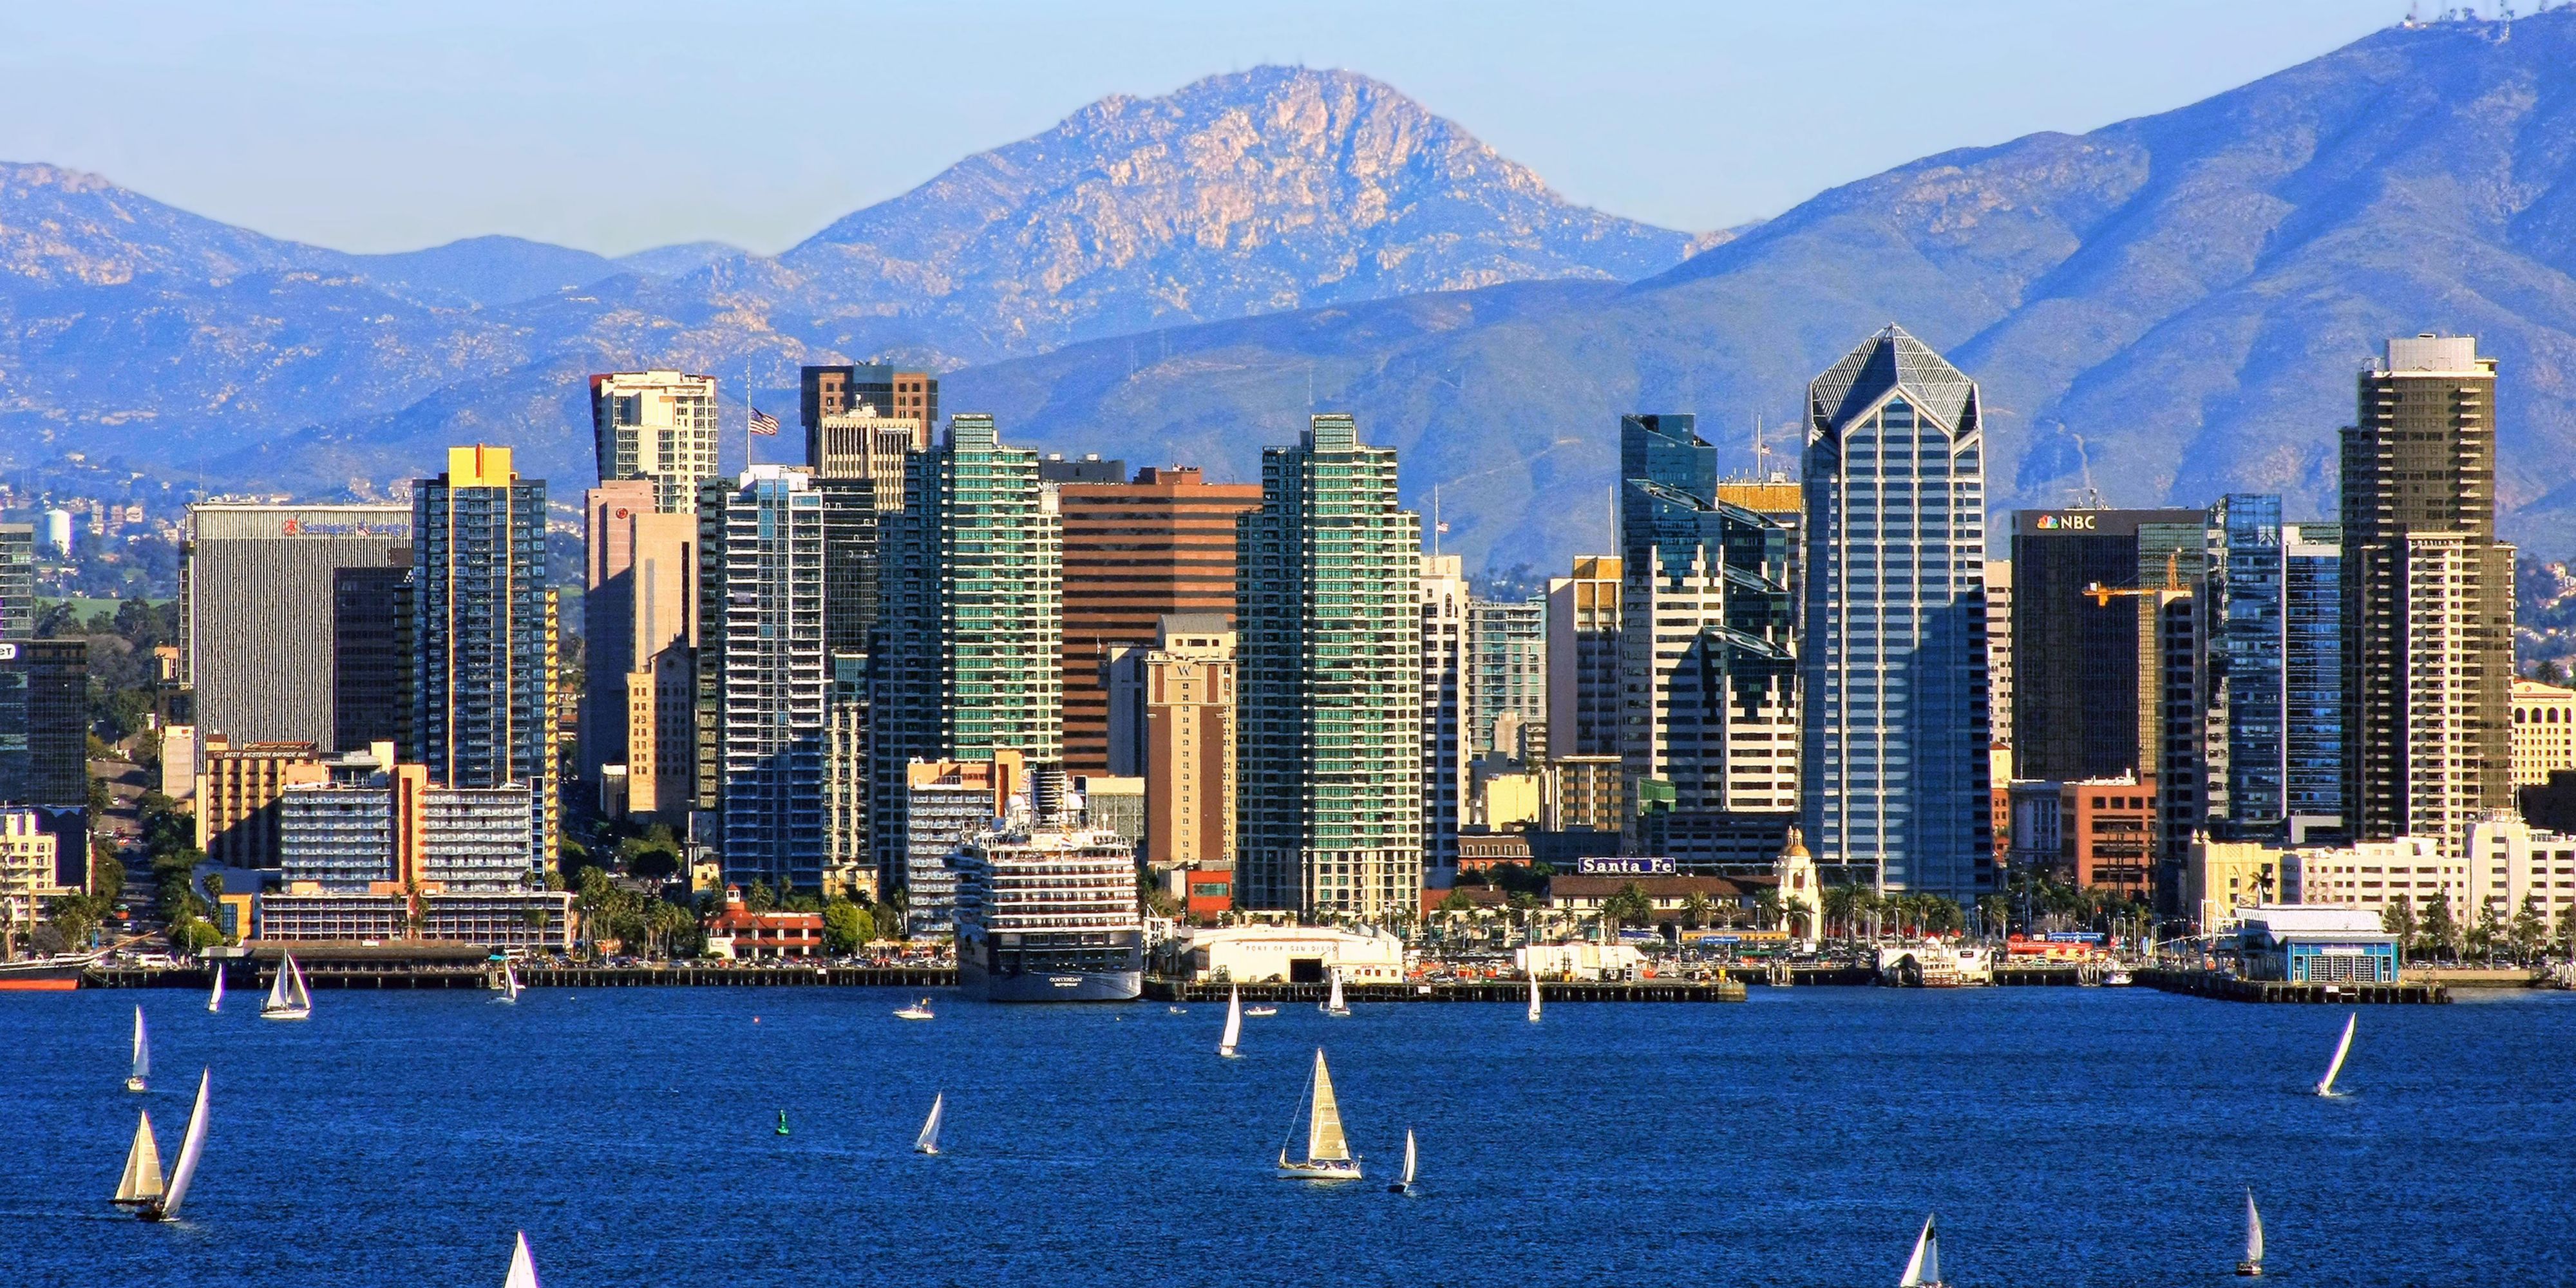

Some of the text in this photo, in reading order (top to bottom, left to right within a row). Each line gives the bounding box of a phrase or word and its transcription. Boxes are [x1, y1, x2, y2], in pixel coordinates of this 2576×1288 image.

[2061, 516, 2095, 529] NBC
[1177, 665, 1191, 676] W
[1584, 859, 1672, 873] Santa Fe
